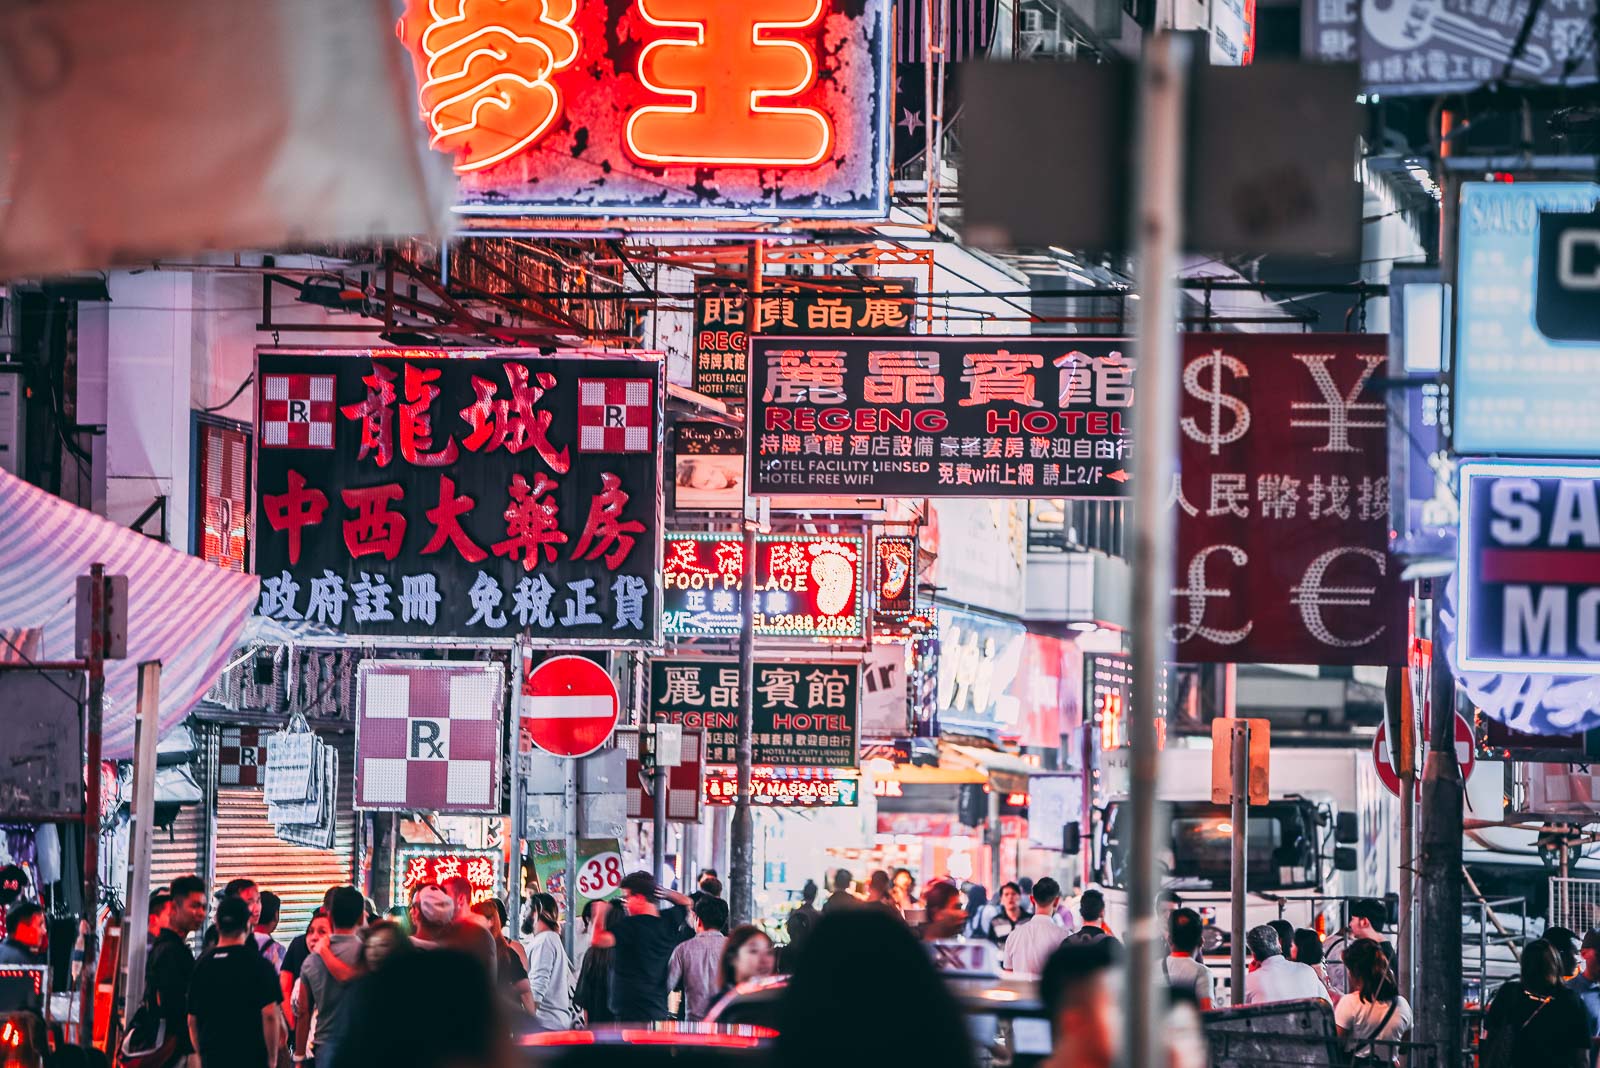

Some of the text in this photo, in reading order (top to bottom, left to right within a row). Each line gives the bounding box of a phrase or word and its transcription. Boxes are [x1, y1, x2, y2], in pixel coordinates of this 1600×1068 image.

[698, 373, 725, 383] HOTEL
[698, 383, 744, 394] HOTEL FREE
[761, 349, 1137, 409] 麗晶賓館
[340, 362, 571, 475] 龍城
[764, 407, 1132, 435] REGENG HOTEL
[760, 433, 1136, 460] 持牌賓館 酒店設備 豪華套房 歡迎自由行
[759, 459, 930, 473] HOTEL FACILITY LIENSED
[938, 462, 1104, 486] 免費wifi上網 請上2/F
[759, 472, 875, 485] HOTEL FREE WIFI
[262, 469, 648, 571] 中西大藥房
[664, 573, 809, 592] FOOT PLACE
[258, 570, 648, 630] 政府註冊 免稅正貨
[752, 614, 814, 631] EL:2388
[658, 667, 850, 709] 麗晶賓館
[655, 711, 852, 731] REGEN HOTEL
[762, 755, 797, 764] HOTEL
[799, 756, 823, 764] FREE
[825, 756, 850, 764] WIFI
[767, 782, 840, 797] MASSAGE
[578, 856, 622, 894] $38
